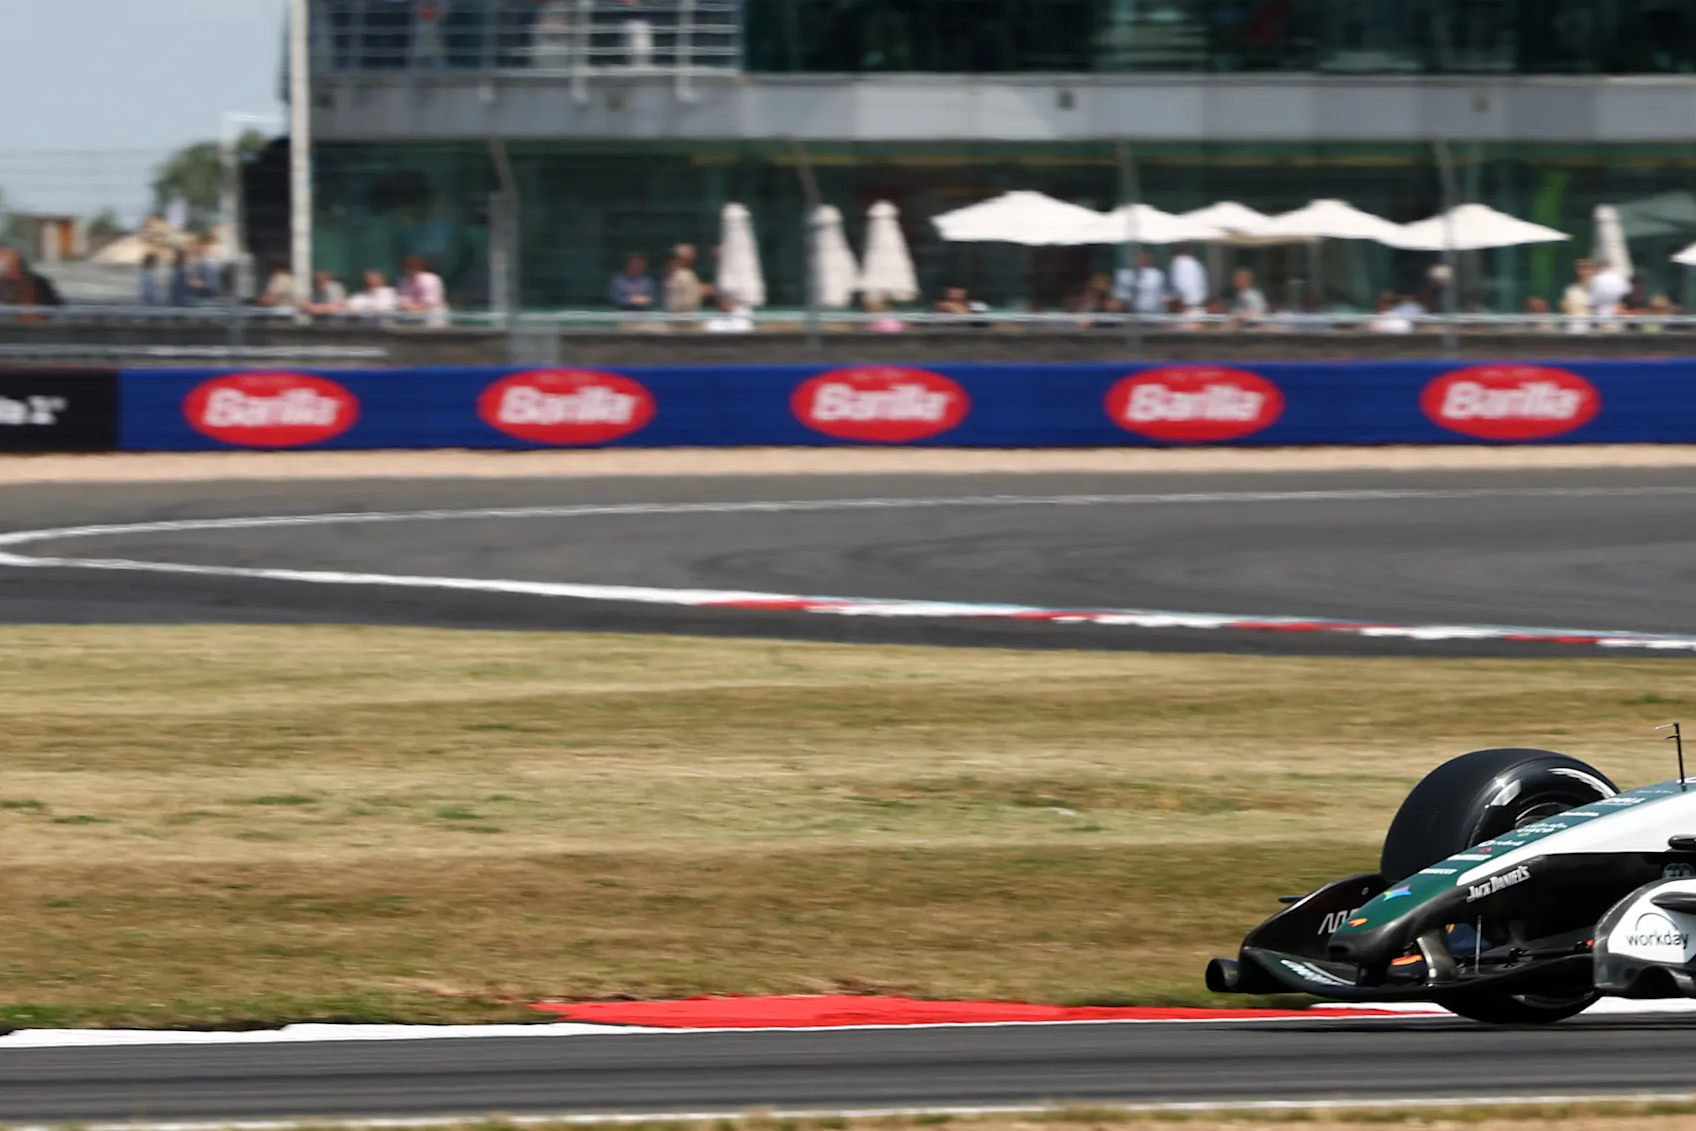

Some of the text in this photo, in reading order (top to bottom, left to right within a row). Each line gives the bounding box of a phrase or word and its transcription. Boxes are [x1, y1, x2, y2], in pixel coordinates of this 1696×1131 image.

[205, 389, 338, 426] Barilla
[499, 386, 635, 424] Barilla
[812, 384, 949, 421] Barilla
[1127, 384, 1263, 421] Barilla
[1442, 382, 1581, 419] Barilla
[1626, 929, 1690, 950] workday
